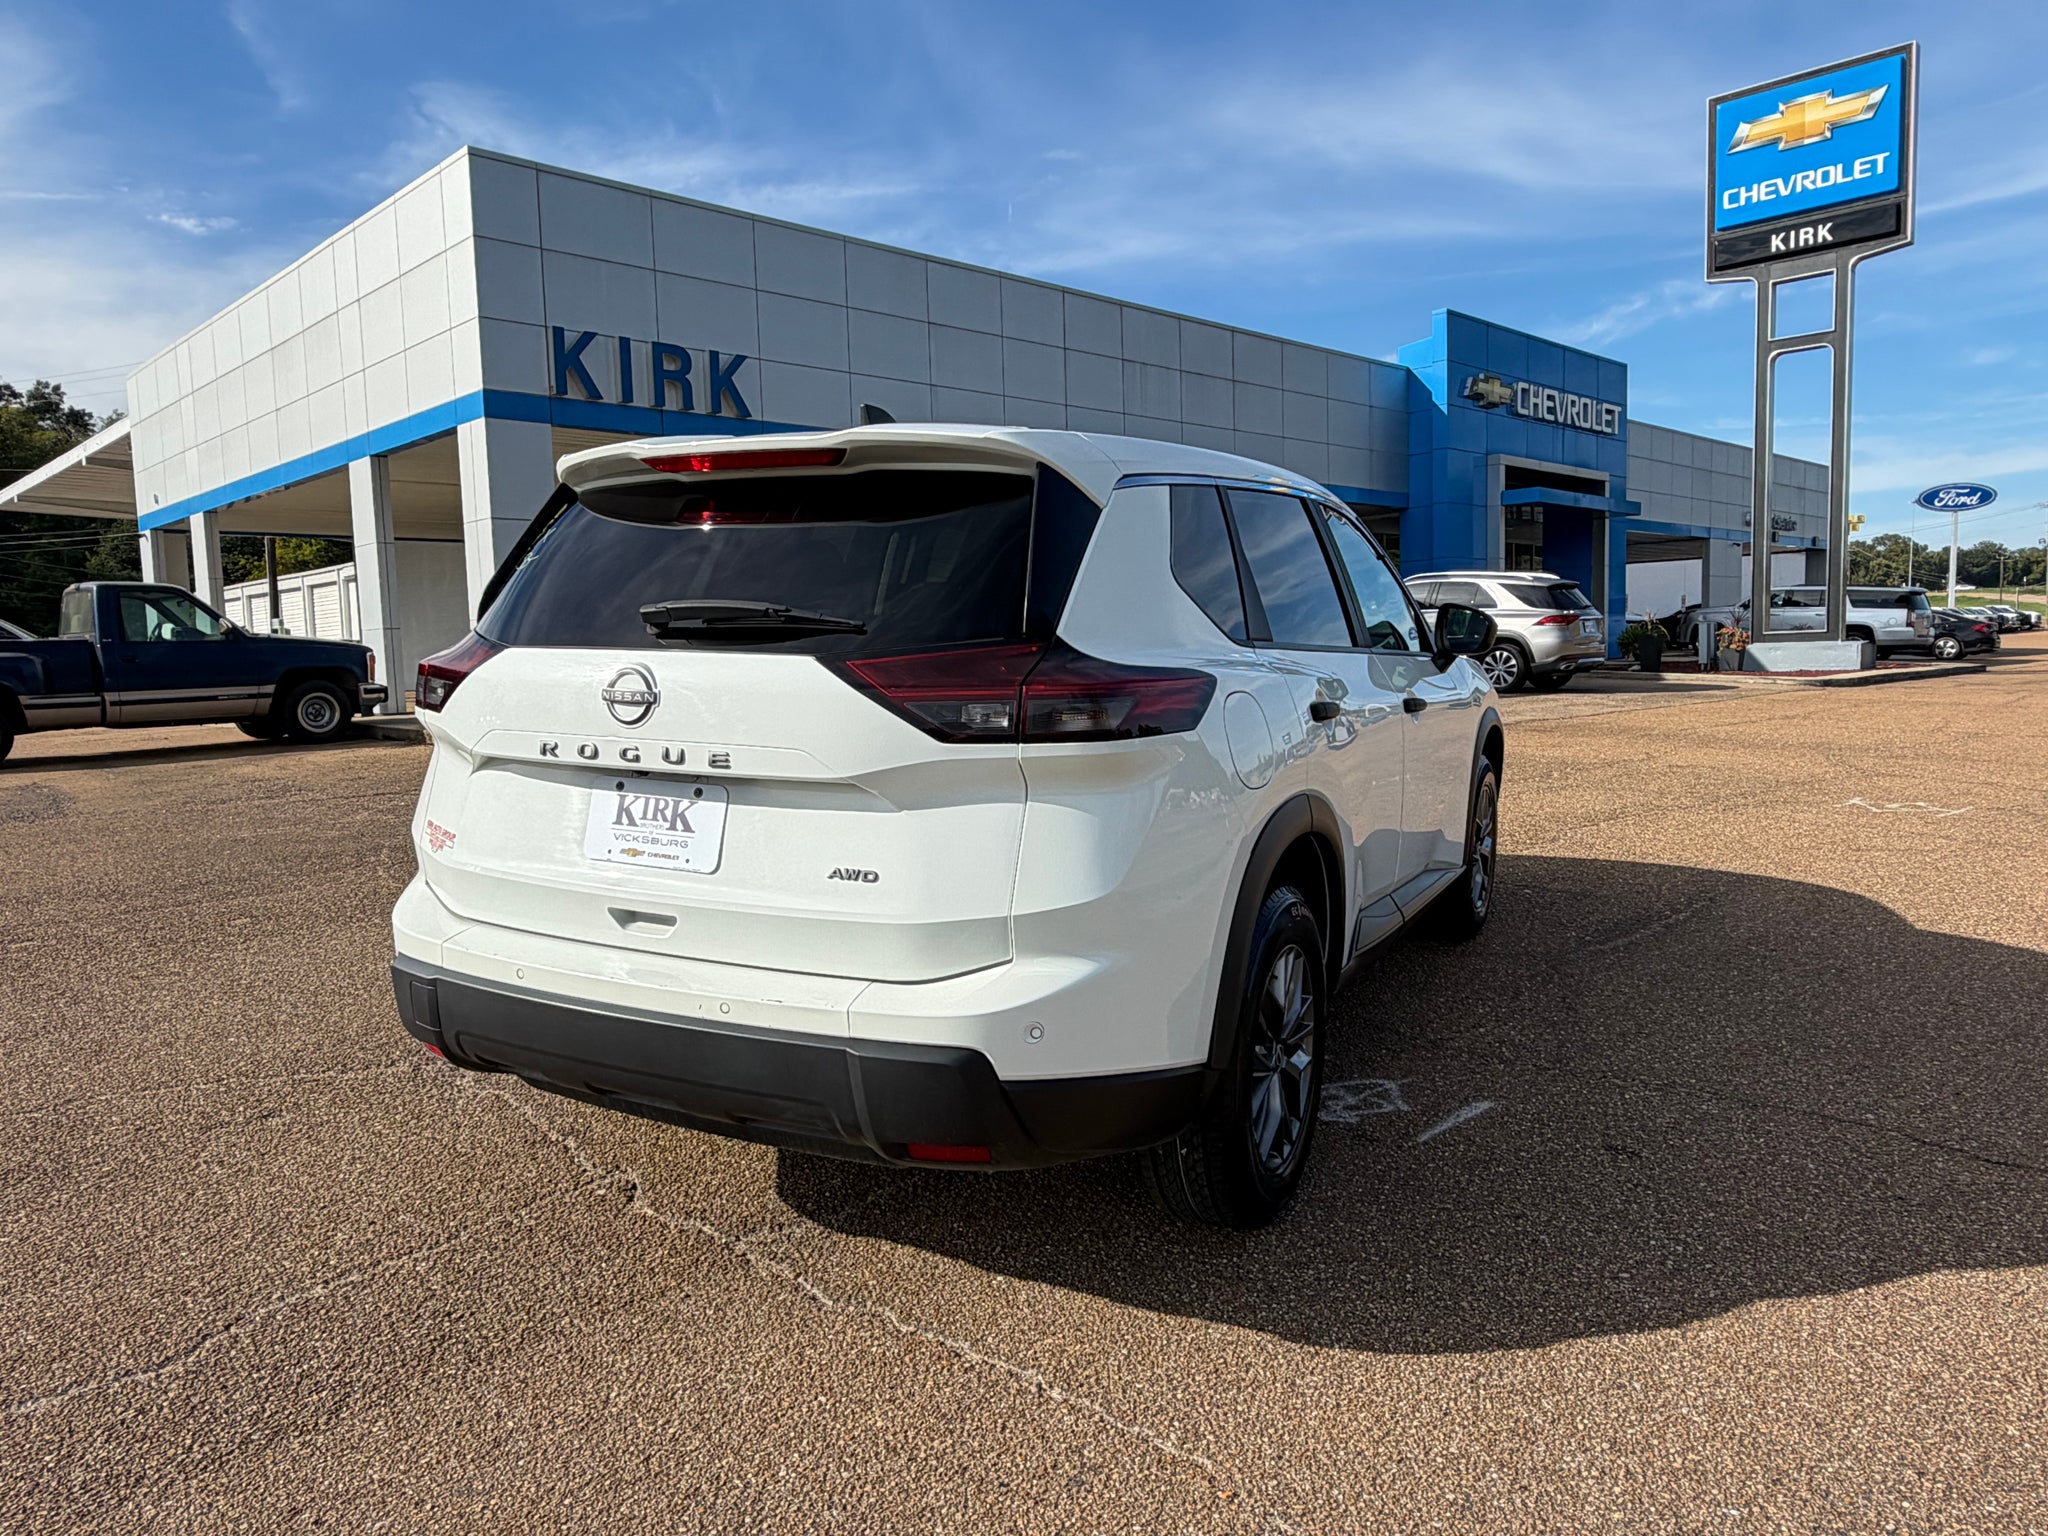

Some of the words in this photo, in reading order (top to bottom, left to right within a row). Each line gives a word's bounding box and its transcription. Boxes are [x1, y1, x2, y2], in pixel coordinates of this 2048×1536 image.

[1722, 151, 1891, 210] CHEVROLET
[1771, 222, 1834, 252] KIRK
[551, 325, 753, 418] KIRK
[1514, 381, 1622, 436] CHEVROLET
[1933, 488, 1983, 508] Ford
[602, 690, 655, 702] NISSAN
[539, 739, 732, 770] ROGUE
[611, 793, 699, 834] KIRK
[613, 832, 689, 849] VICKSBURG
[647, 851, 680, 861] CHEVROLET
[827, 867, 880, 884] AWD
